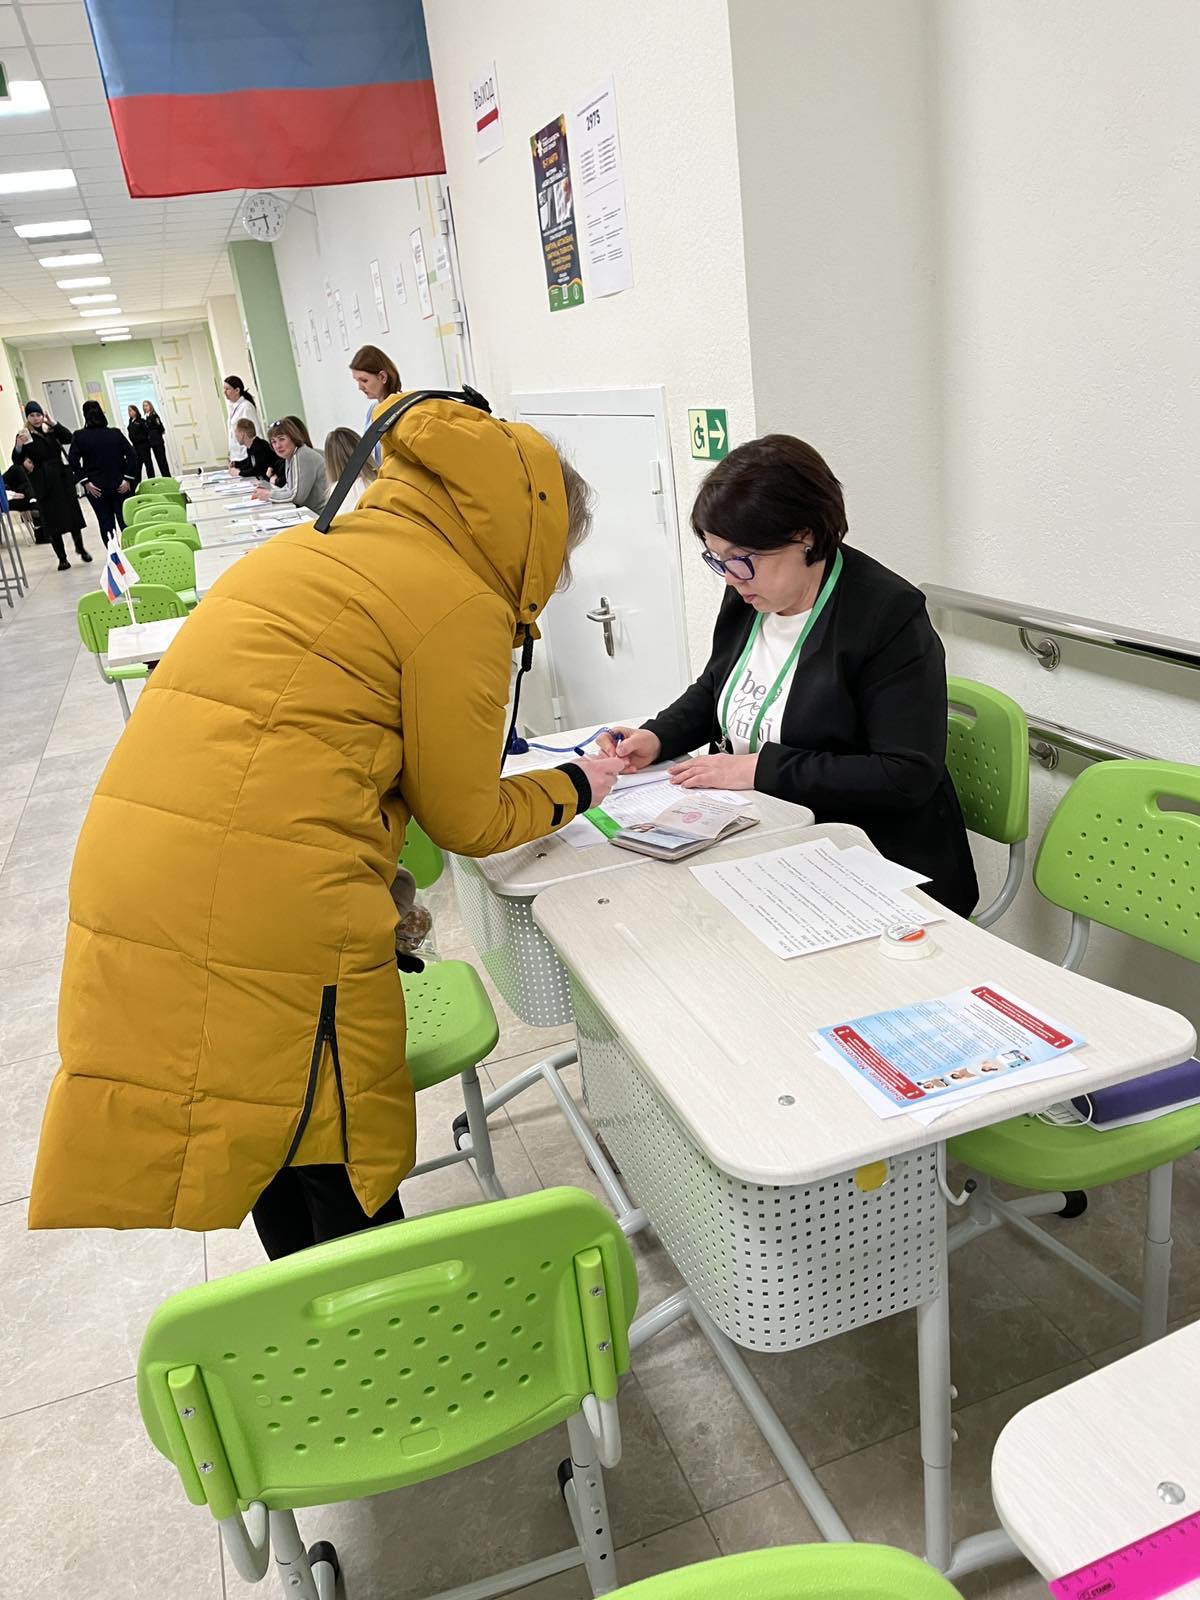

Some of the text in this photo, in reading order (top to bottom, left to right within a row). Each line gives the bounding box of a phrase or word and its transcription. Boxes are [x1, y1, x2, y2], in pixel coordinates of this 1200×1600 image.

[473, 77, 495, 110] ВЫХОД
[586, 109, 600, 131] 2975
[740, 669, 766, 701] be
